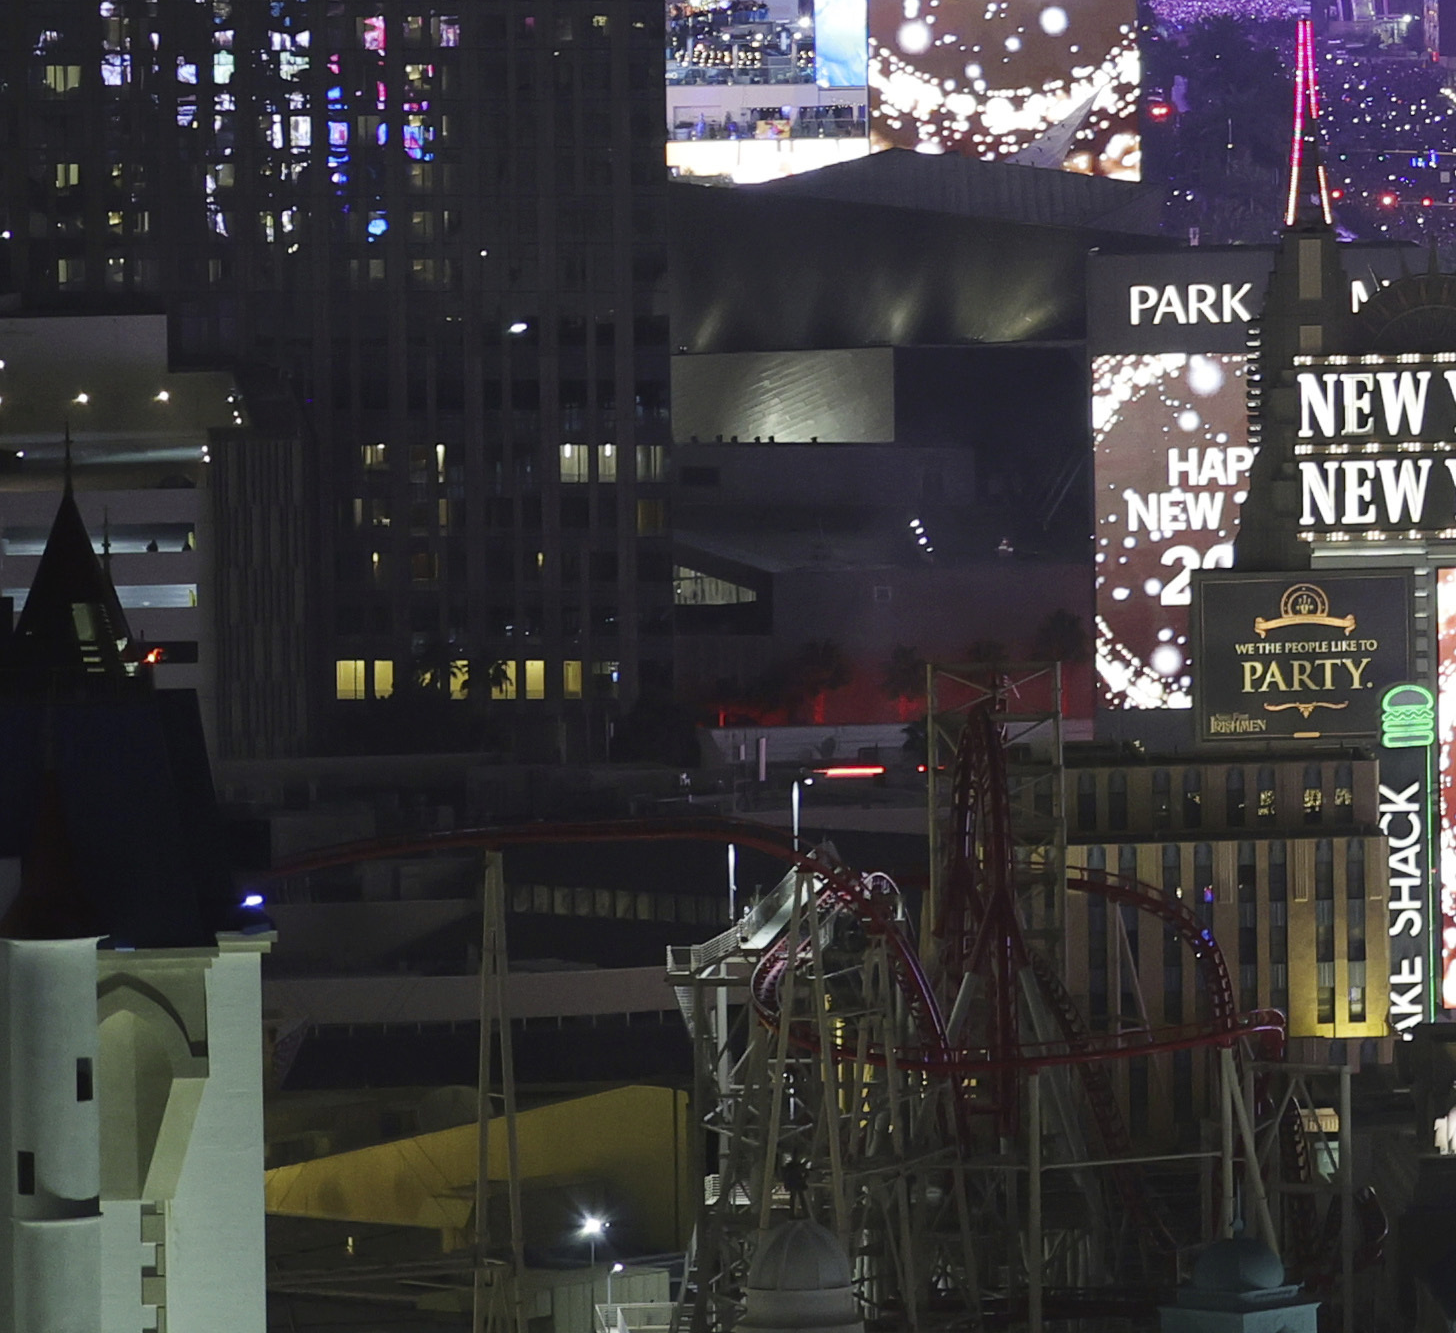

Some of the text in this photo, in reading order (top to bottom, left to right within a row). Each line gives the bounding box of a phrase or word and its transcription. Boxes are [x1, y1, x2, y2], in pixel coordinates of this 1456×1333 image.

[1129, 283, 1253, 325] PARK
[1297, 371, 1432, 438] NEW
[1126, 493, 1225, 532] NEW
[1299, 458, 1432, 526] NEW
[1235, 639, 1378, 655] WE THE PEOPLE LIKE TO
[1241, 658, 1374, 693] PARTY.
[1379, 781, 1422, 938] SHACK
